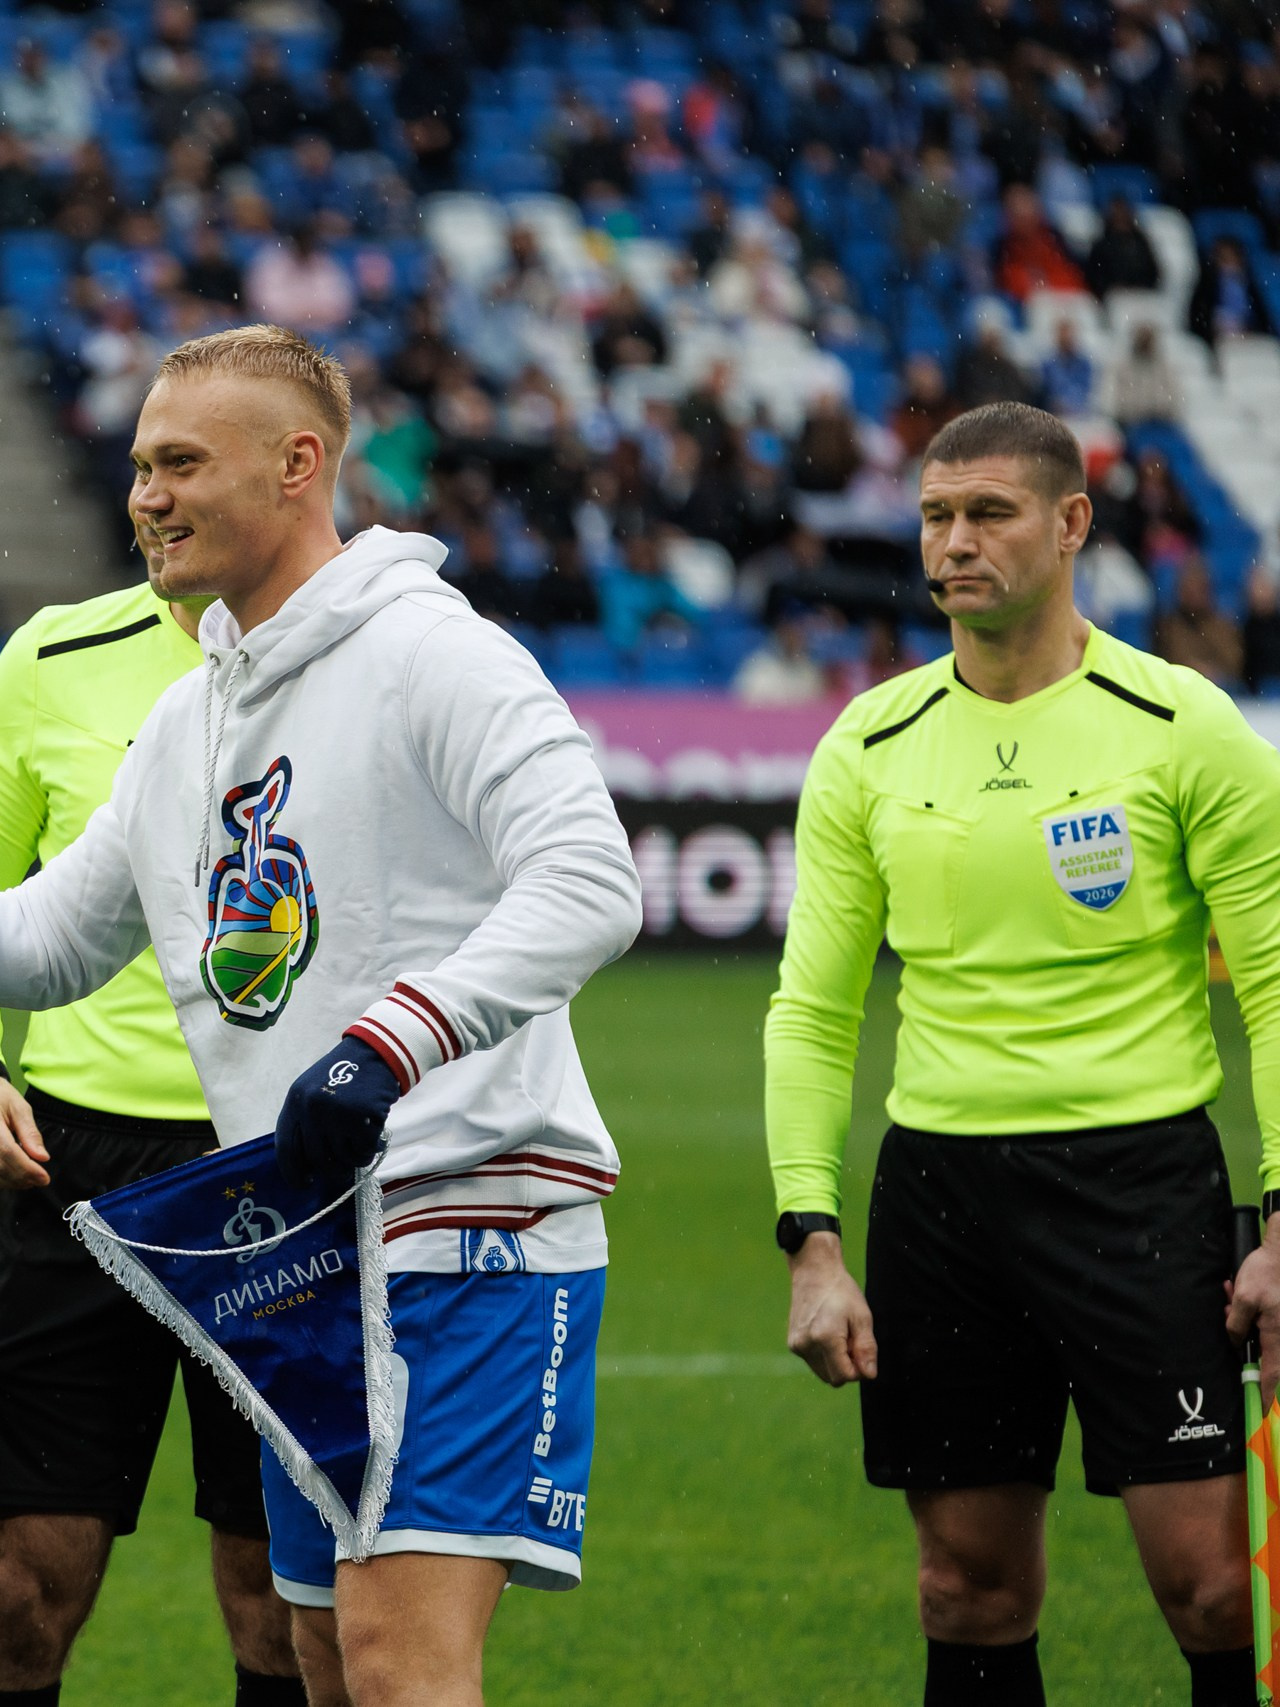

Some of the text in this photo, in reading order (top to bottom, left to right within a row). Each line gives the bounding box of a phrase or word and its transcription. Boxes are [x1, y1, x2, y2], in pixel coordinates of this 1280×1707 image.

[978, 777, 1033, 793] JÖGEL
[1051, 812, 1121, 847] FIFA
[1059, 846, 1124, 869] ASSISTANT
[1066, 858, 1122, 880] REFEREE
[1084, 886, 1116, 903] 2026
[214, 1248, 344, 1325] ДИНАМО
[252, 1290, 317, 1321] МОСКВА
[533, 1287, 569, 1457] BetBoom
[1168, 1423, 1226, 1443] JÖGEL
